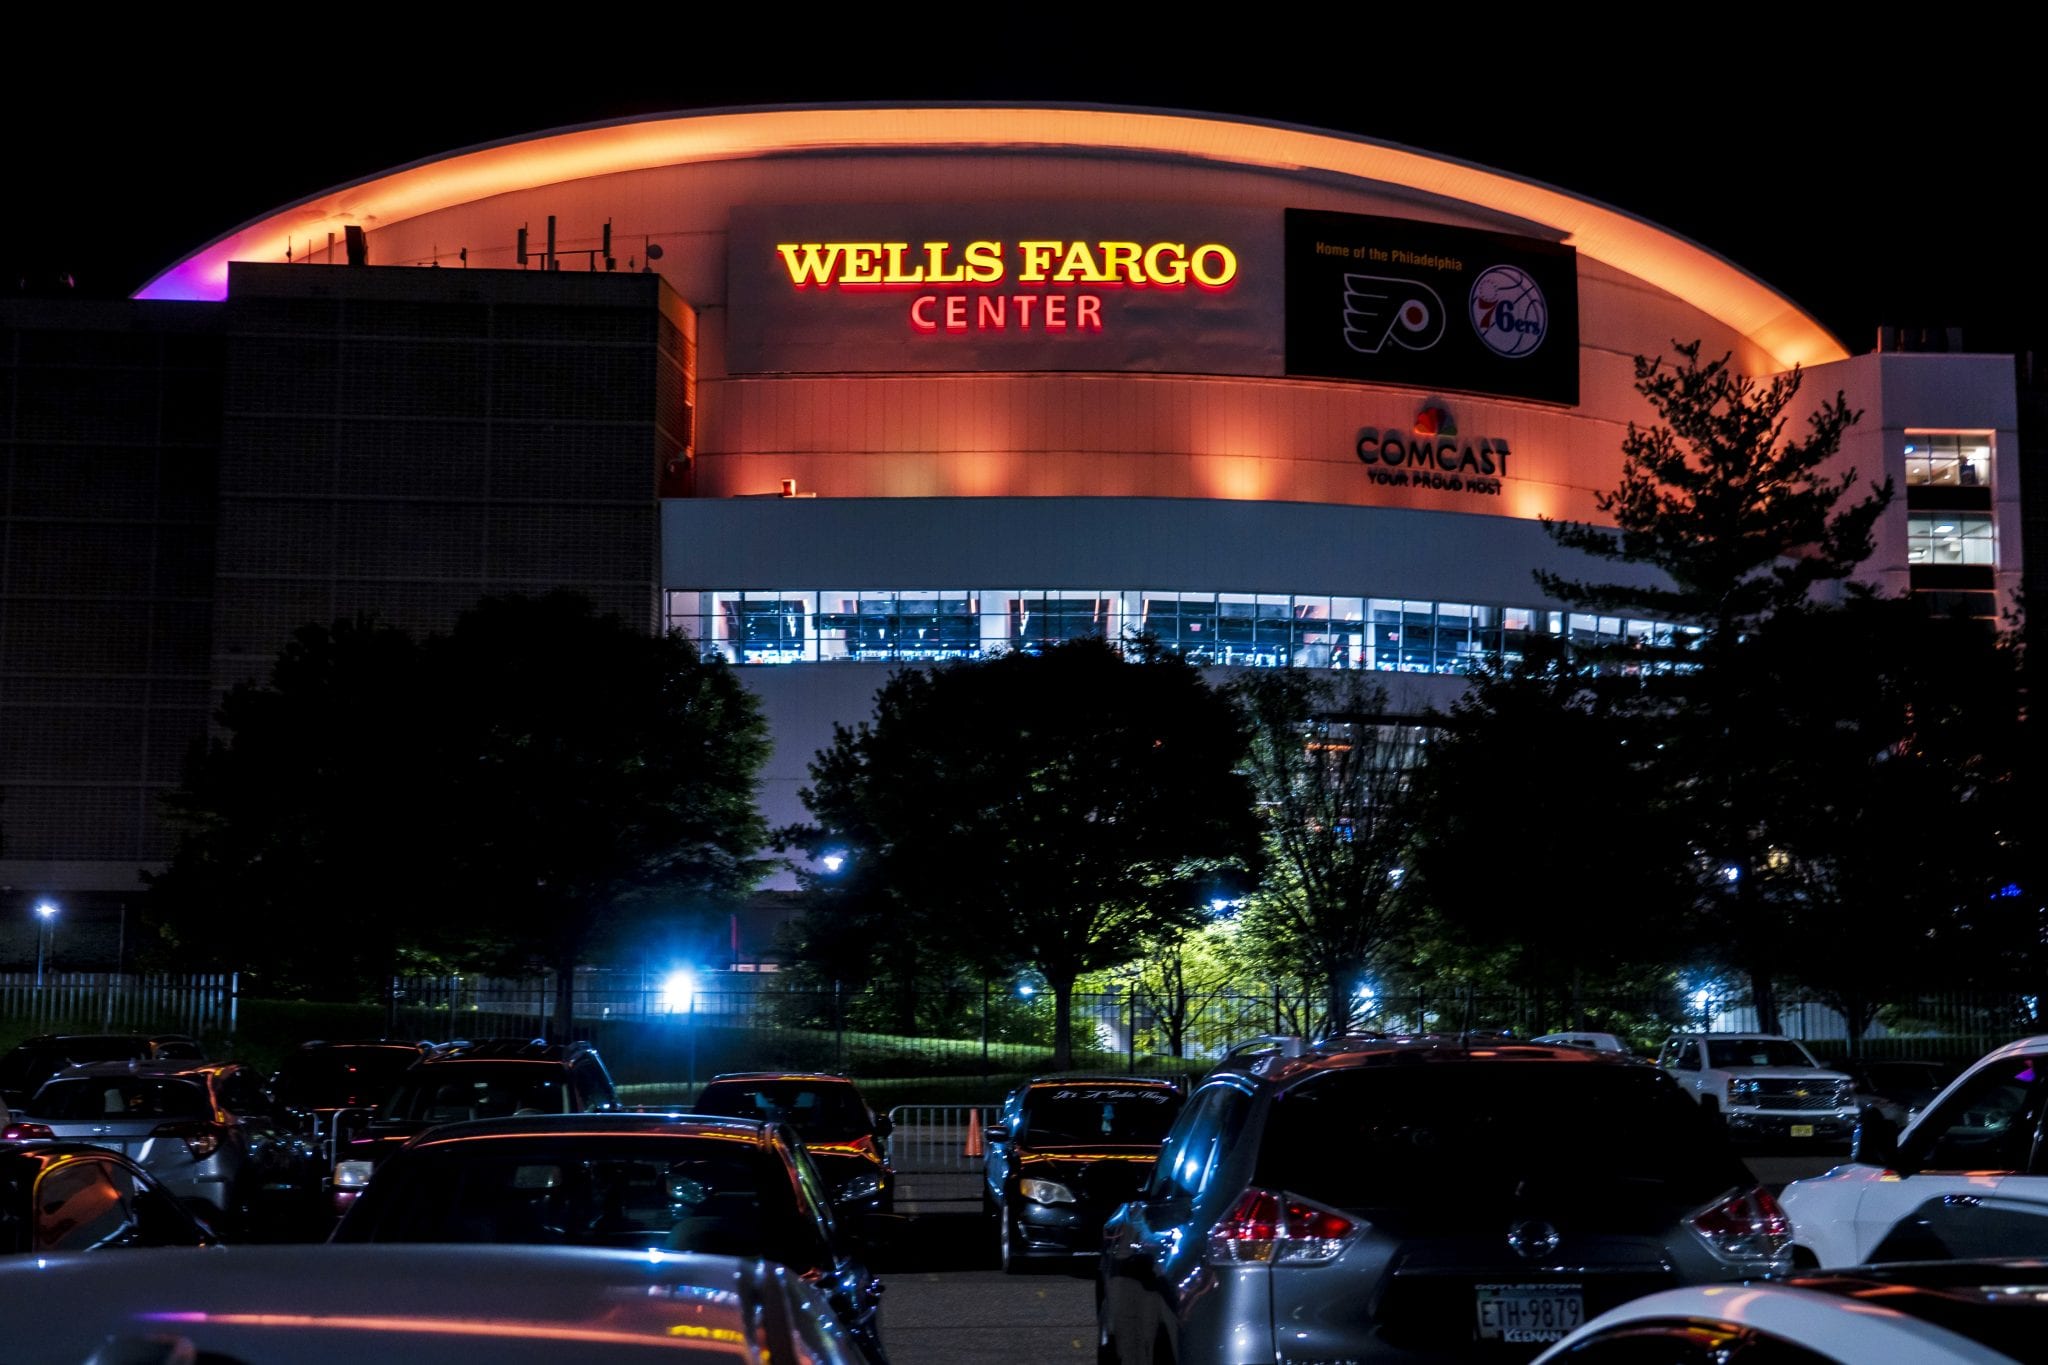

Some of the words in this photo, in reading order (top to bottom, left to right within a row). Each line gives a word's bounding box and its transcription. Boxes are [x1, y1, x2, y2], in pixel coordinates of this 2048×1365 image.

[776, 240, 1005, 284] WELLS
[1018, 240, 1239, 286] FARGO
[1315, 241, 1350, 257] Home
[1353, 246, 1365, 260] of
[1369, 247, 1389, 262] the
[1391, 249, 1463, 271] Philadelphia
[911, 295, 1102, 330] CENTER
[1478, 299, 1540, 335] 76ers
[1356, 437, 1511, 476] COMCAST
[1368, 470, 1408, 487] YOUR
[1413, 474, 1462, 491] PROUD
[1467, 479, 1502, 495] HOST
